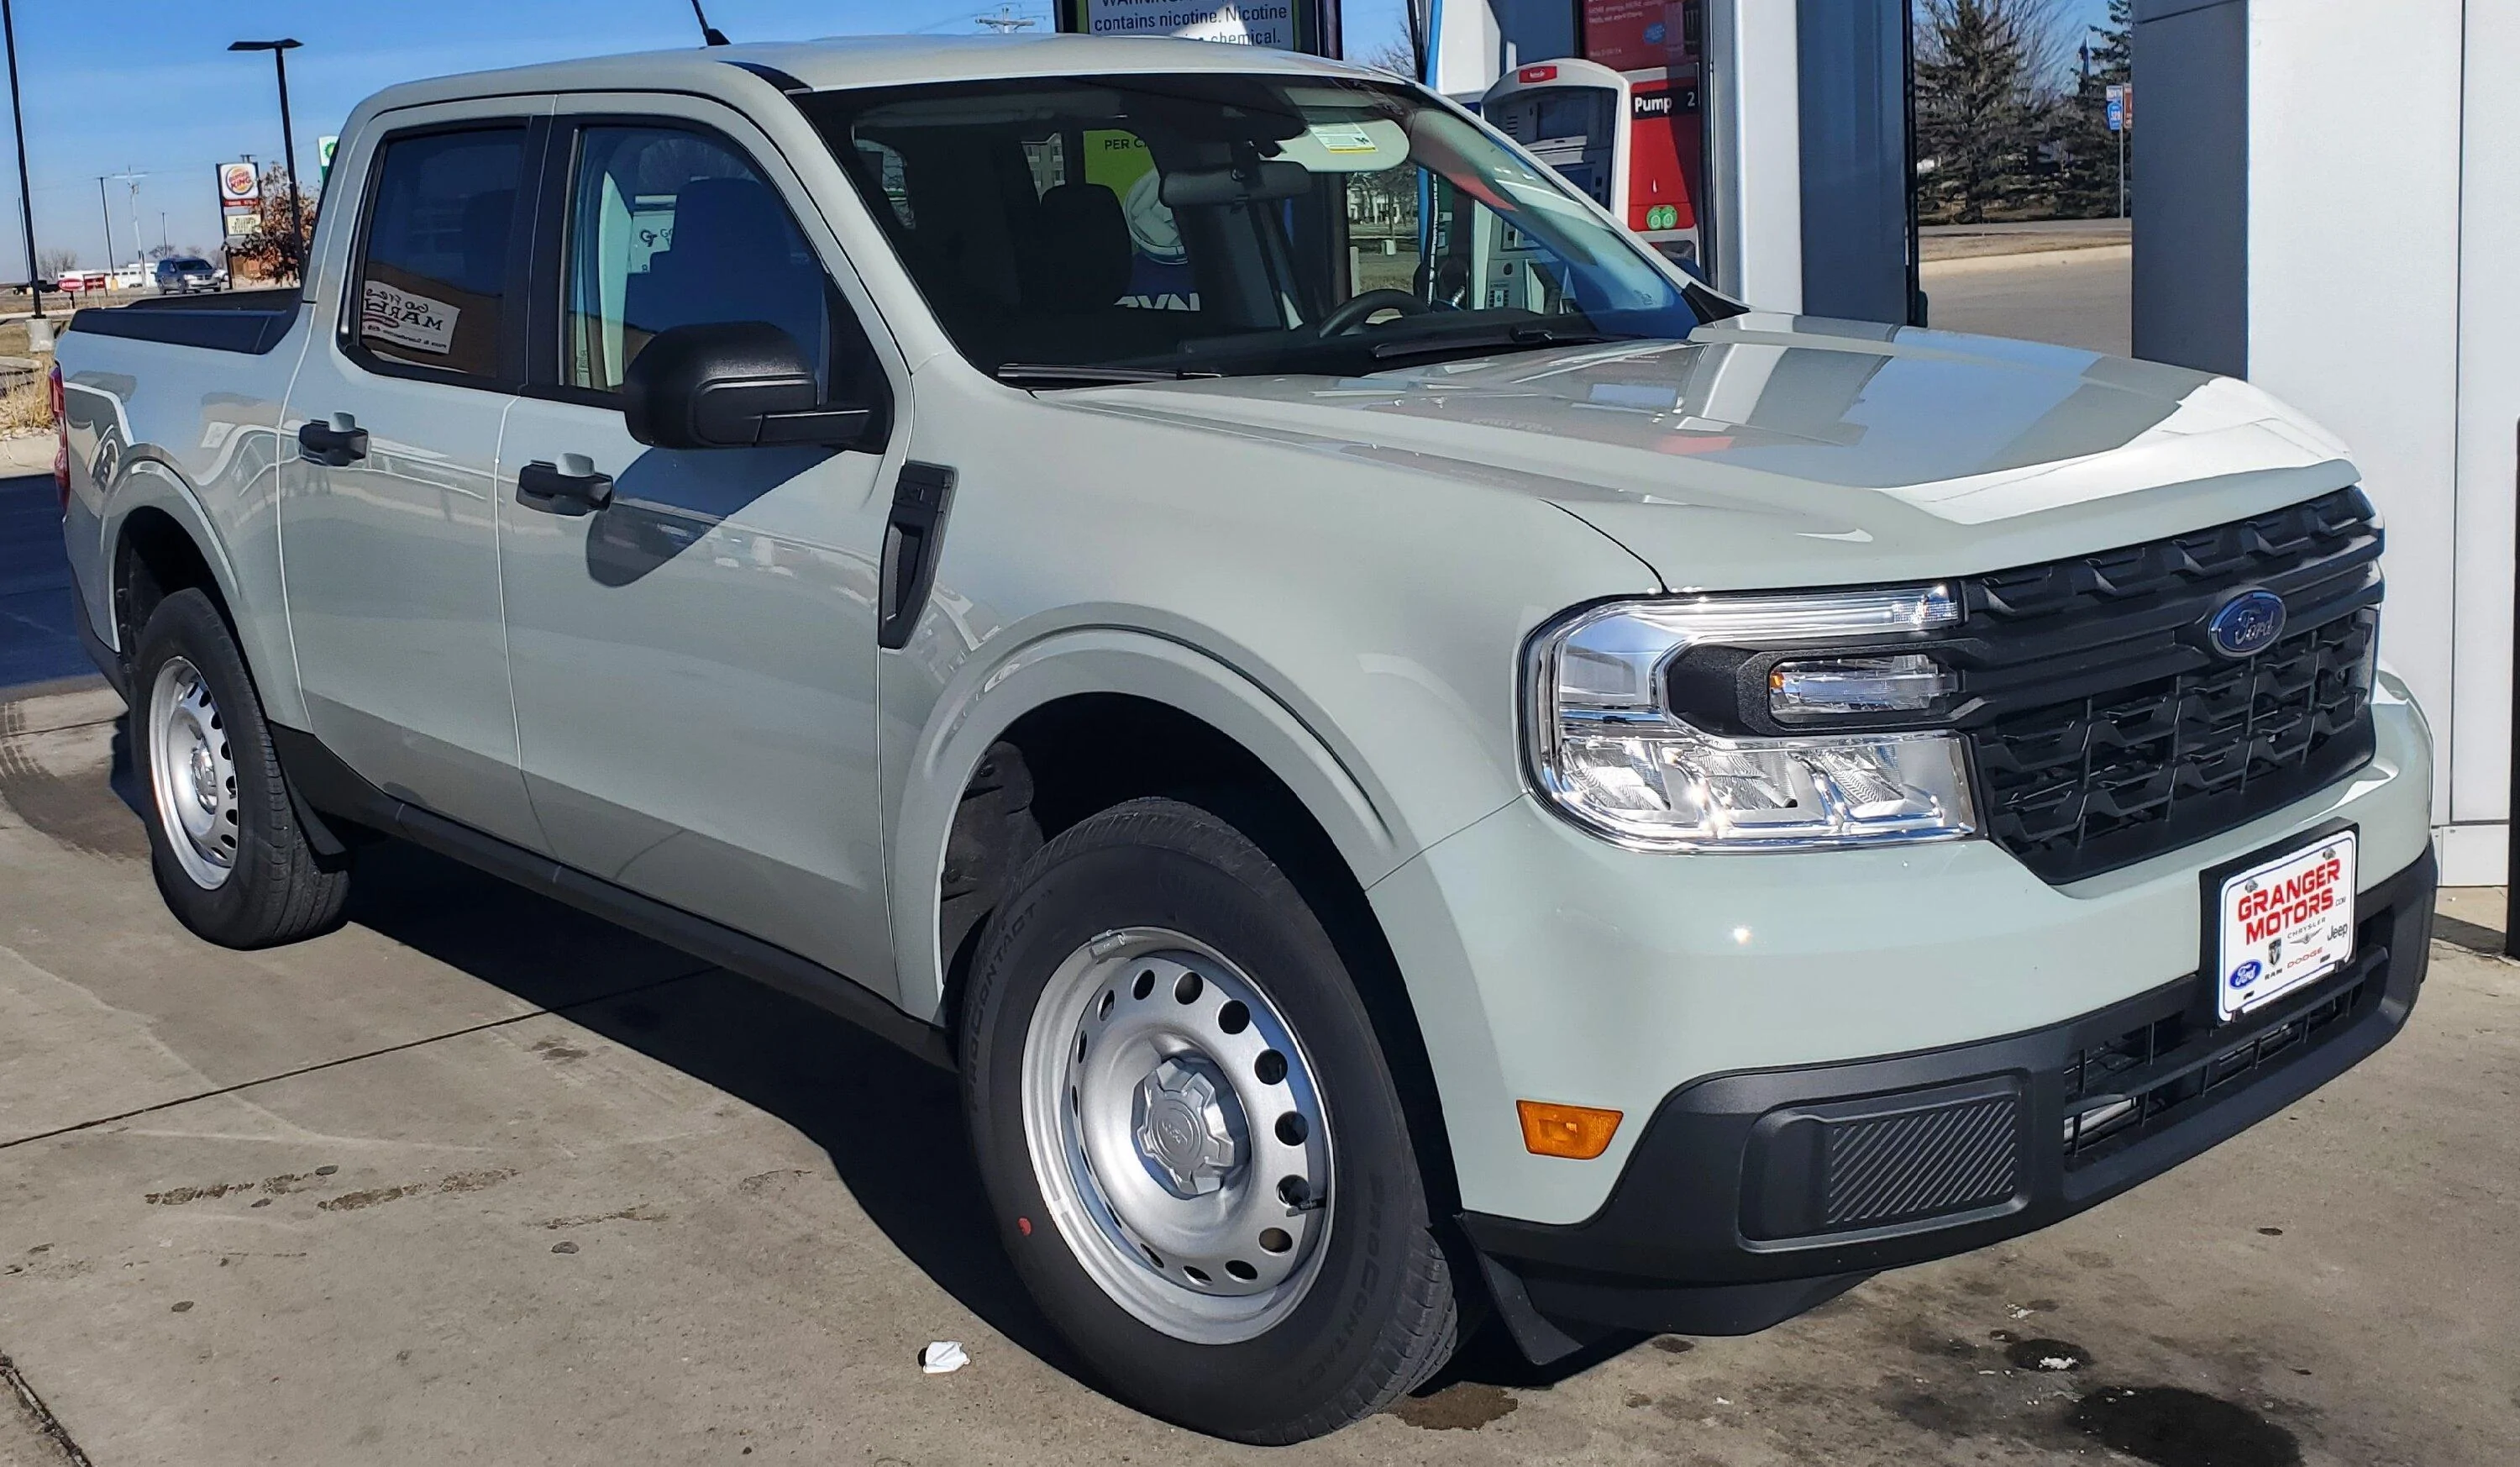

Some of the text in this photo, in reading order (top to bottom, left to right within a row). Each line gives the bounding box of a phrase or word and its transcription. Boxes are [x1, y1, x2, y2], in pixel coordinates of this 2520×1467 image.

[1095, 6, 1287, 31] contains nicotine. Nicotine
[1635, 92, 1695, 113] Pump 2
[1105, 139, 1129, 150] PER
[230, 176, 251, 189] KING
[2234, 608, 2275, 644] Ford
[2238, 859, 2341, 922] GRANGER
[2245, 887, 2334, 945] MOTORS
[2287, 917, 2326, 939] CHRYSLER
[2327, 923, 2348, 941] Jeep
[2286, 947, 2323, 969] DODGE
[2234, 964, 2257, 986] Ford
[2265, 968, 2282, 981] RAM
